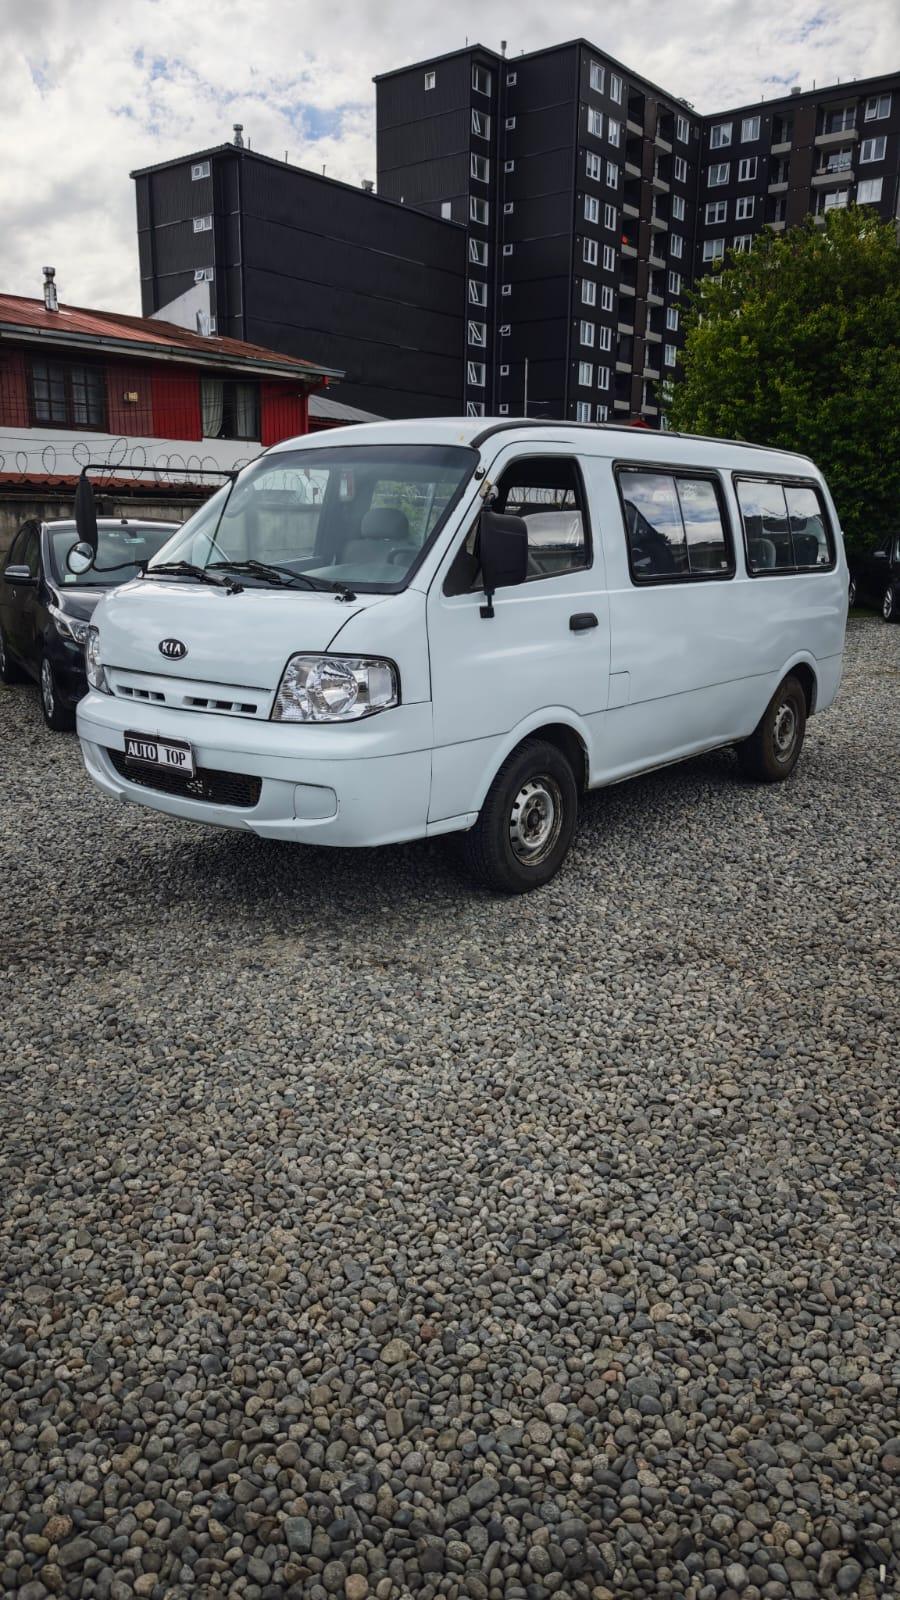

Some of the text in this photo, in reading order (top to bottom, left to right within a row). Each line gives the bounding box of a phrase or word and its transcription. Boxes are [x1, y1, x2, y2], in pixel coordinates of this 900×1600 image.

[161, 640, 182, 656] KIA
[127, 741, 186, 766] AUTO TOP
